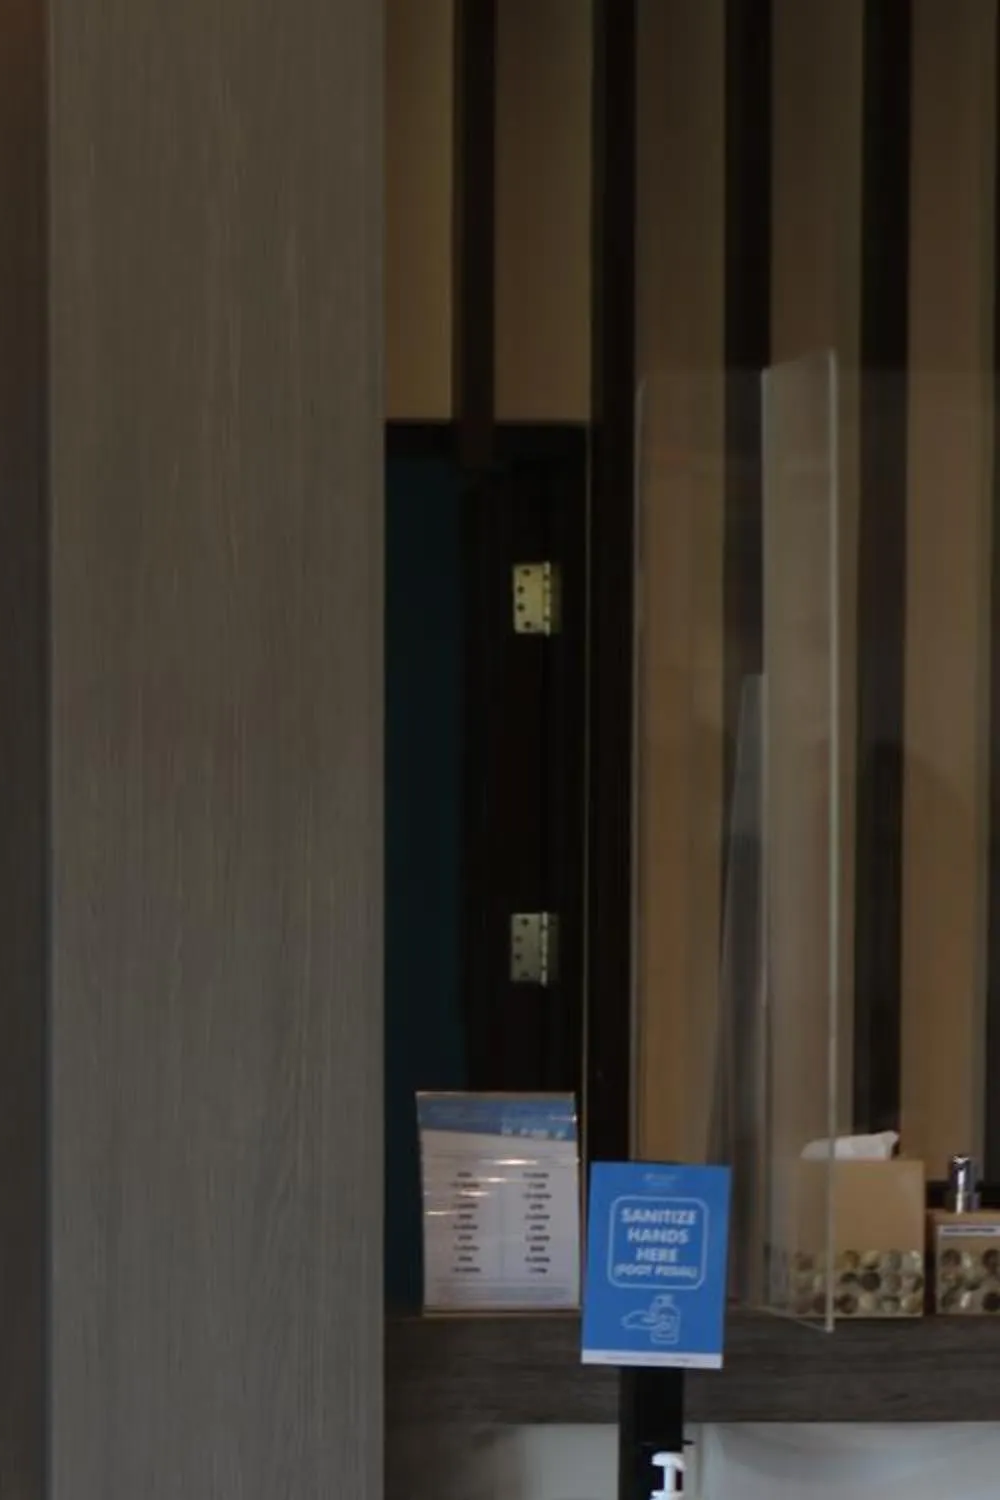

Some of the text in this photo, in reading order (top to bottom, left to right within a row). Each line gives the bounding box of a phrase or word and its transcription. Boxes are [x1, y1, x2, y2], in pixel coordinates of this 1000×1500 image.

[621, 1207, 697, 1226] SANITIZE
[628, 1228, 689, 1245] HANDS
[636, 1247, 678, 1263] HERE
